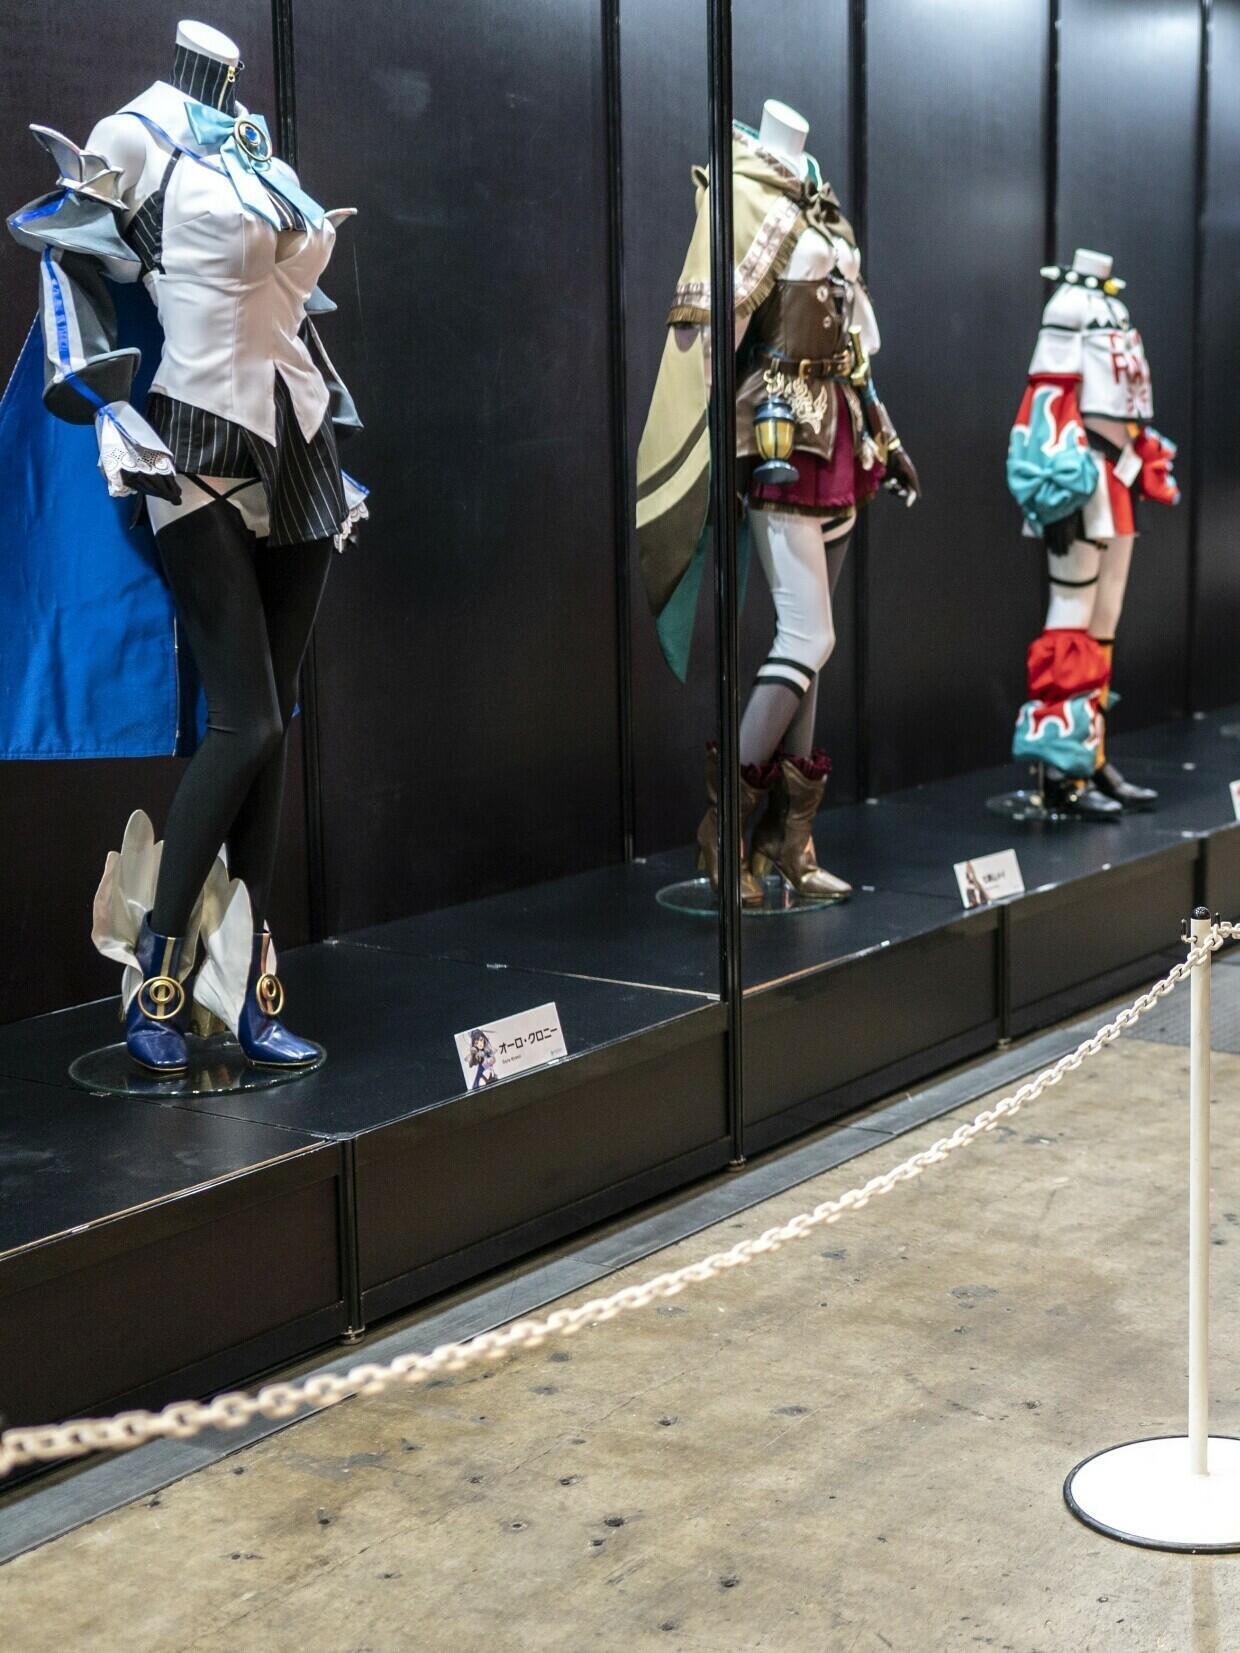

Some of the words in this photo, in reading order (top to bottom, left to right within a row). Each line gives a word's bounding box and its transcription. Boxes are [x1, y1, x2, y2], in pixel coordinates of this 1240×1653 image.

[498, 1027, 559, 1055] オーロ・クロニー
